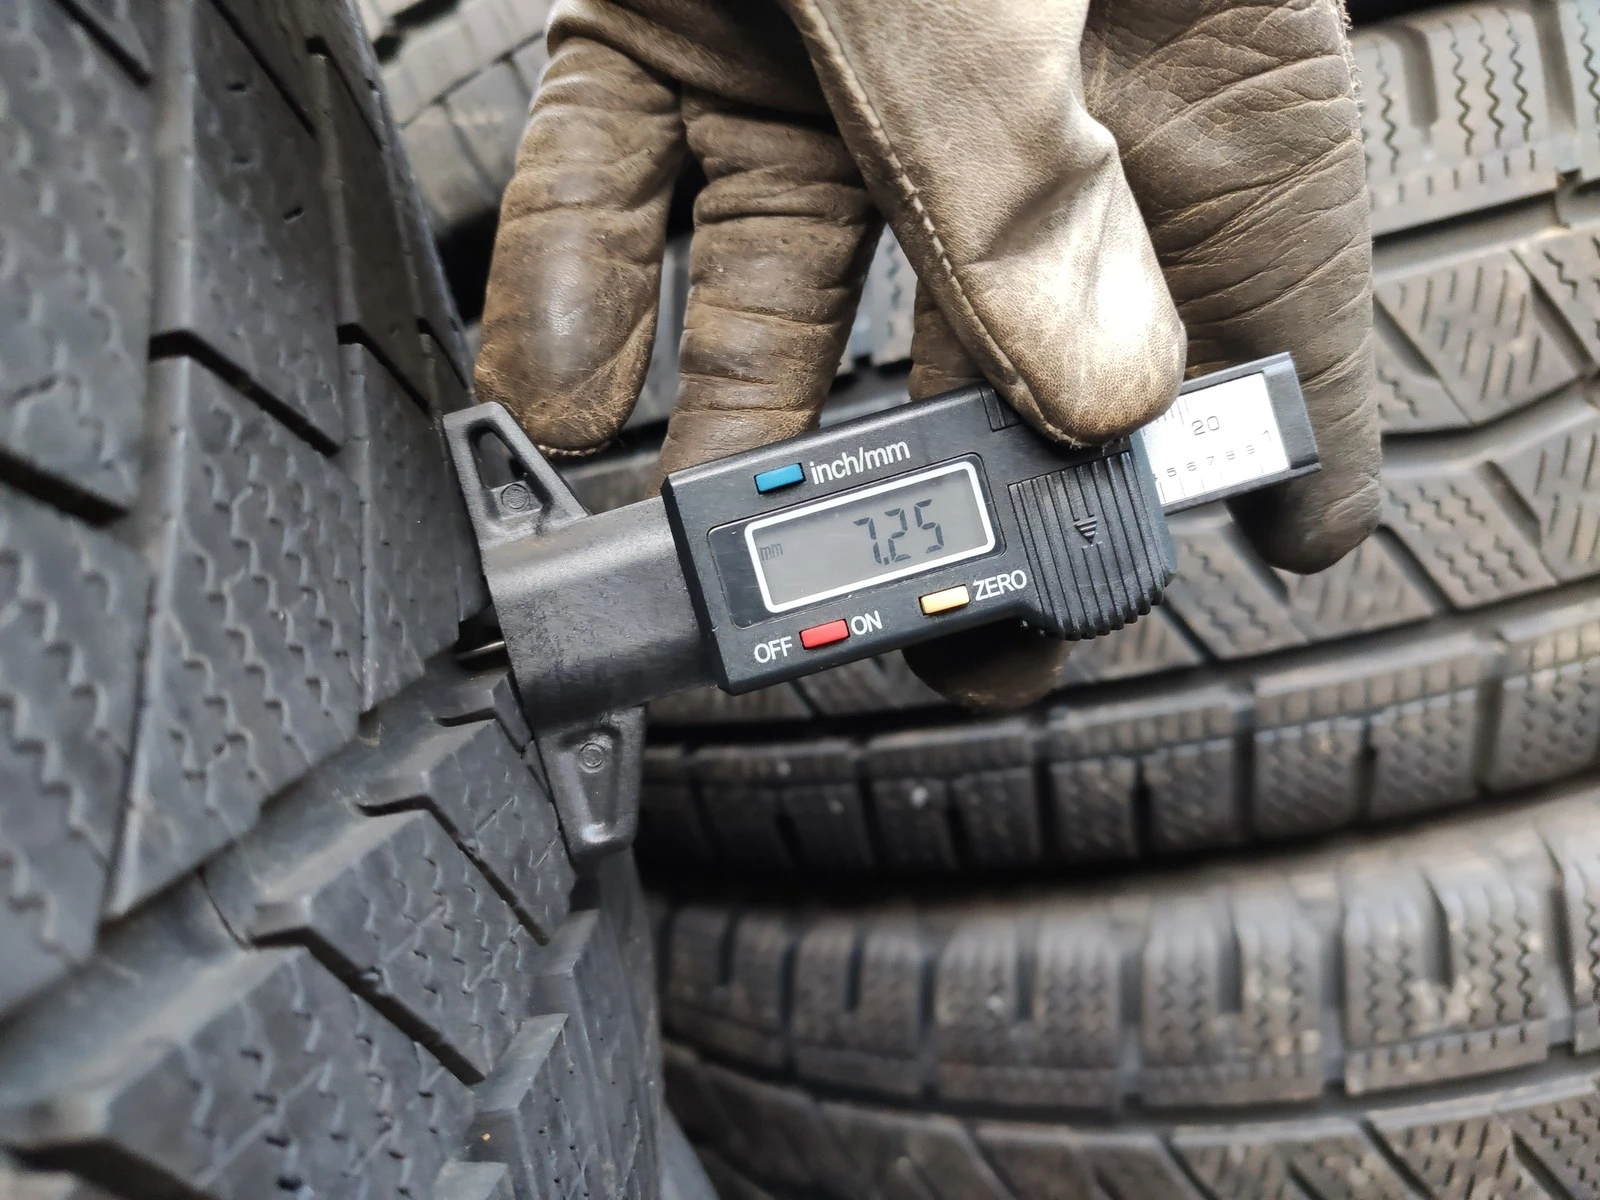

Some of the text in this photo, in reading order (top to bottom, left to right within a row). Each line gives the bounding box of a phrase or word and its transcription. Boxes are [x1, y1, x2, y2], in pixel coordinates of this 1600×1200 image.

[1191, 416, 1220, 436] 20
[810, 440, 911, 485] inch/mm
[1166, 467, 1177, 478] 5
[1206, 455, 1215, 466] 7
[760, 498, 944, 566] mm 7.25
[972, 569, 1027, 601] ZERO
[753, 610, 883, 664] OFF ON
